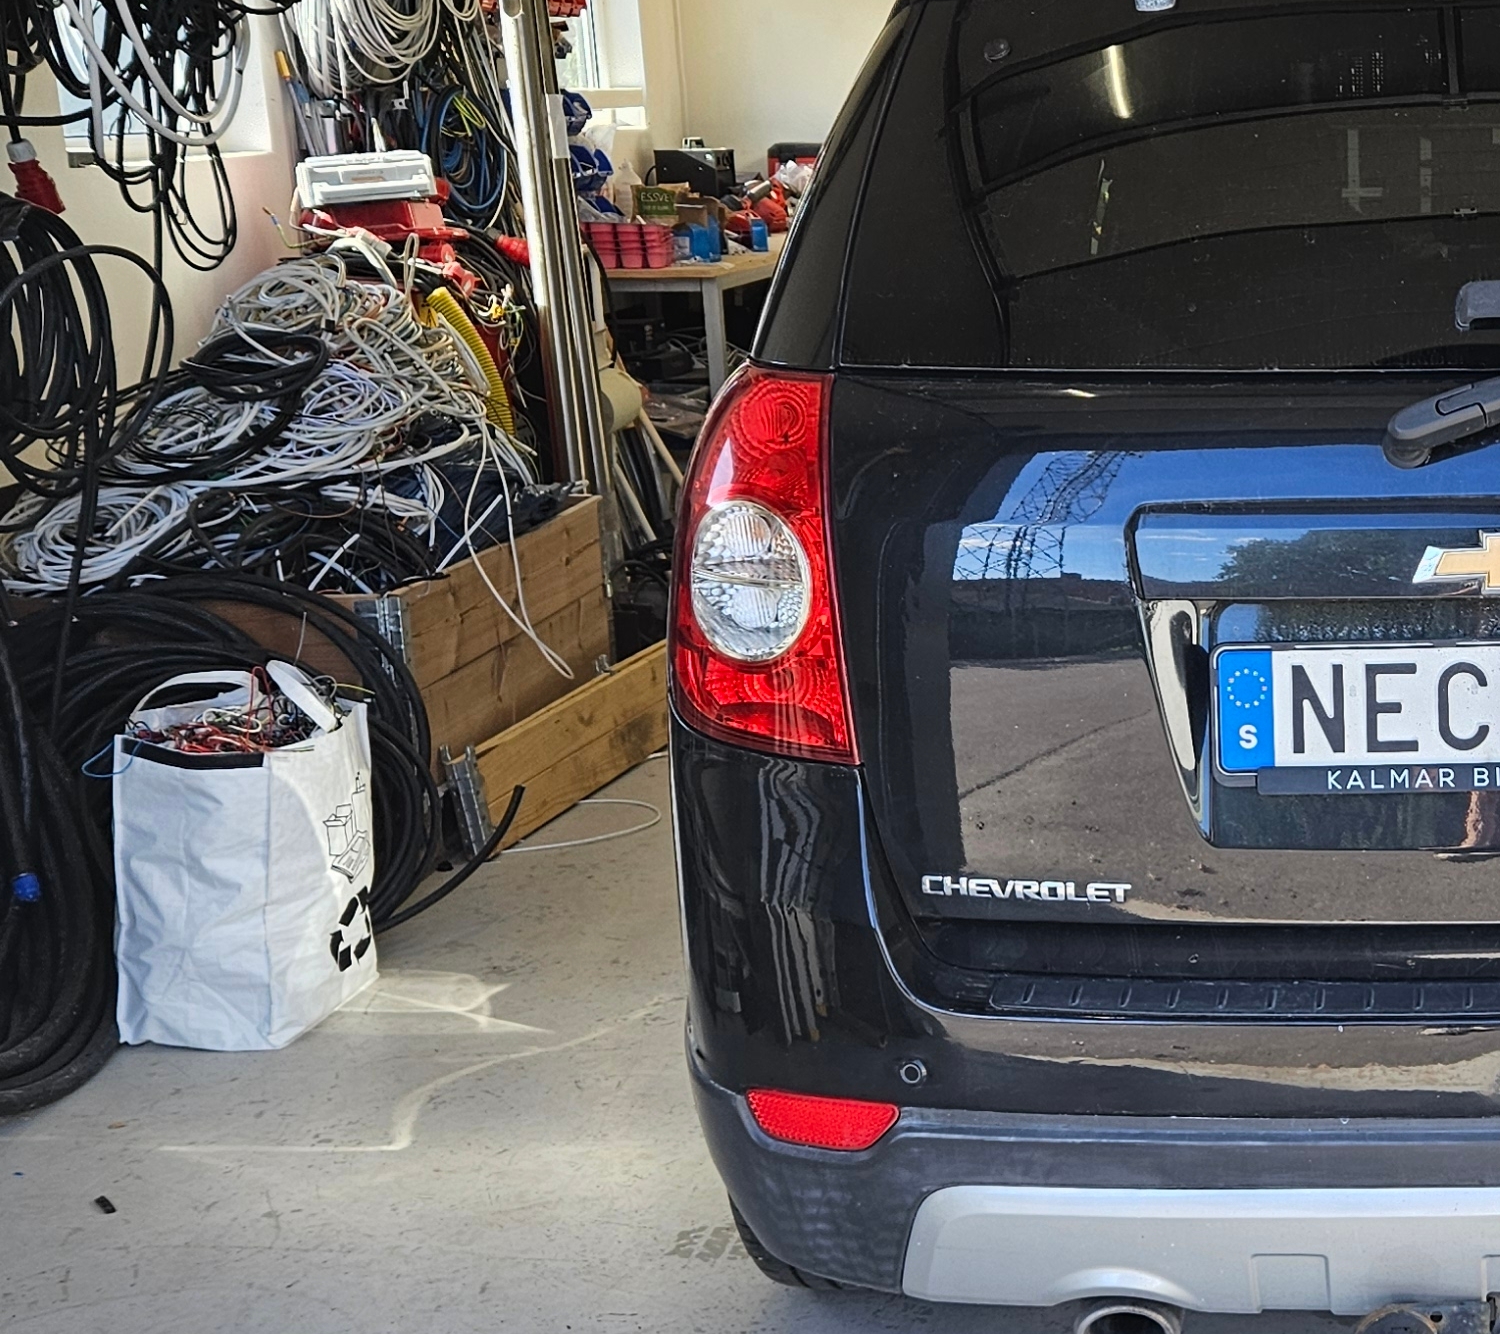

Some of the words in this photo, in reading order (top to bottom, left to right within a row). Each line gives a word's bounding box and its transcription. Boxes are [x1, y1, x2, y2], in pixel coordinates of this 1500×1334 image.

[1291, 661, 1490, 754] NEC
[1238, 724, 1258, 750] S
[1327, 768, 1456, 790] KALMAR
[921, 874, 1132, 903] CHEVROLET
